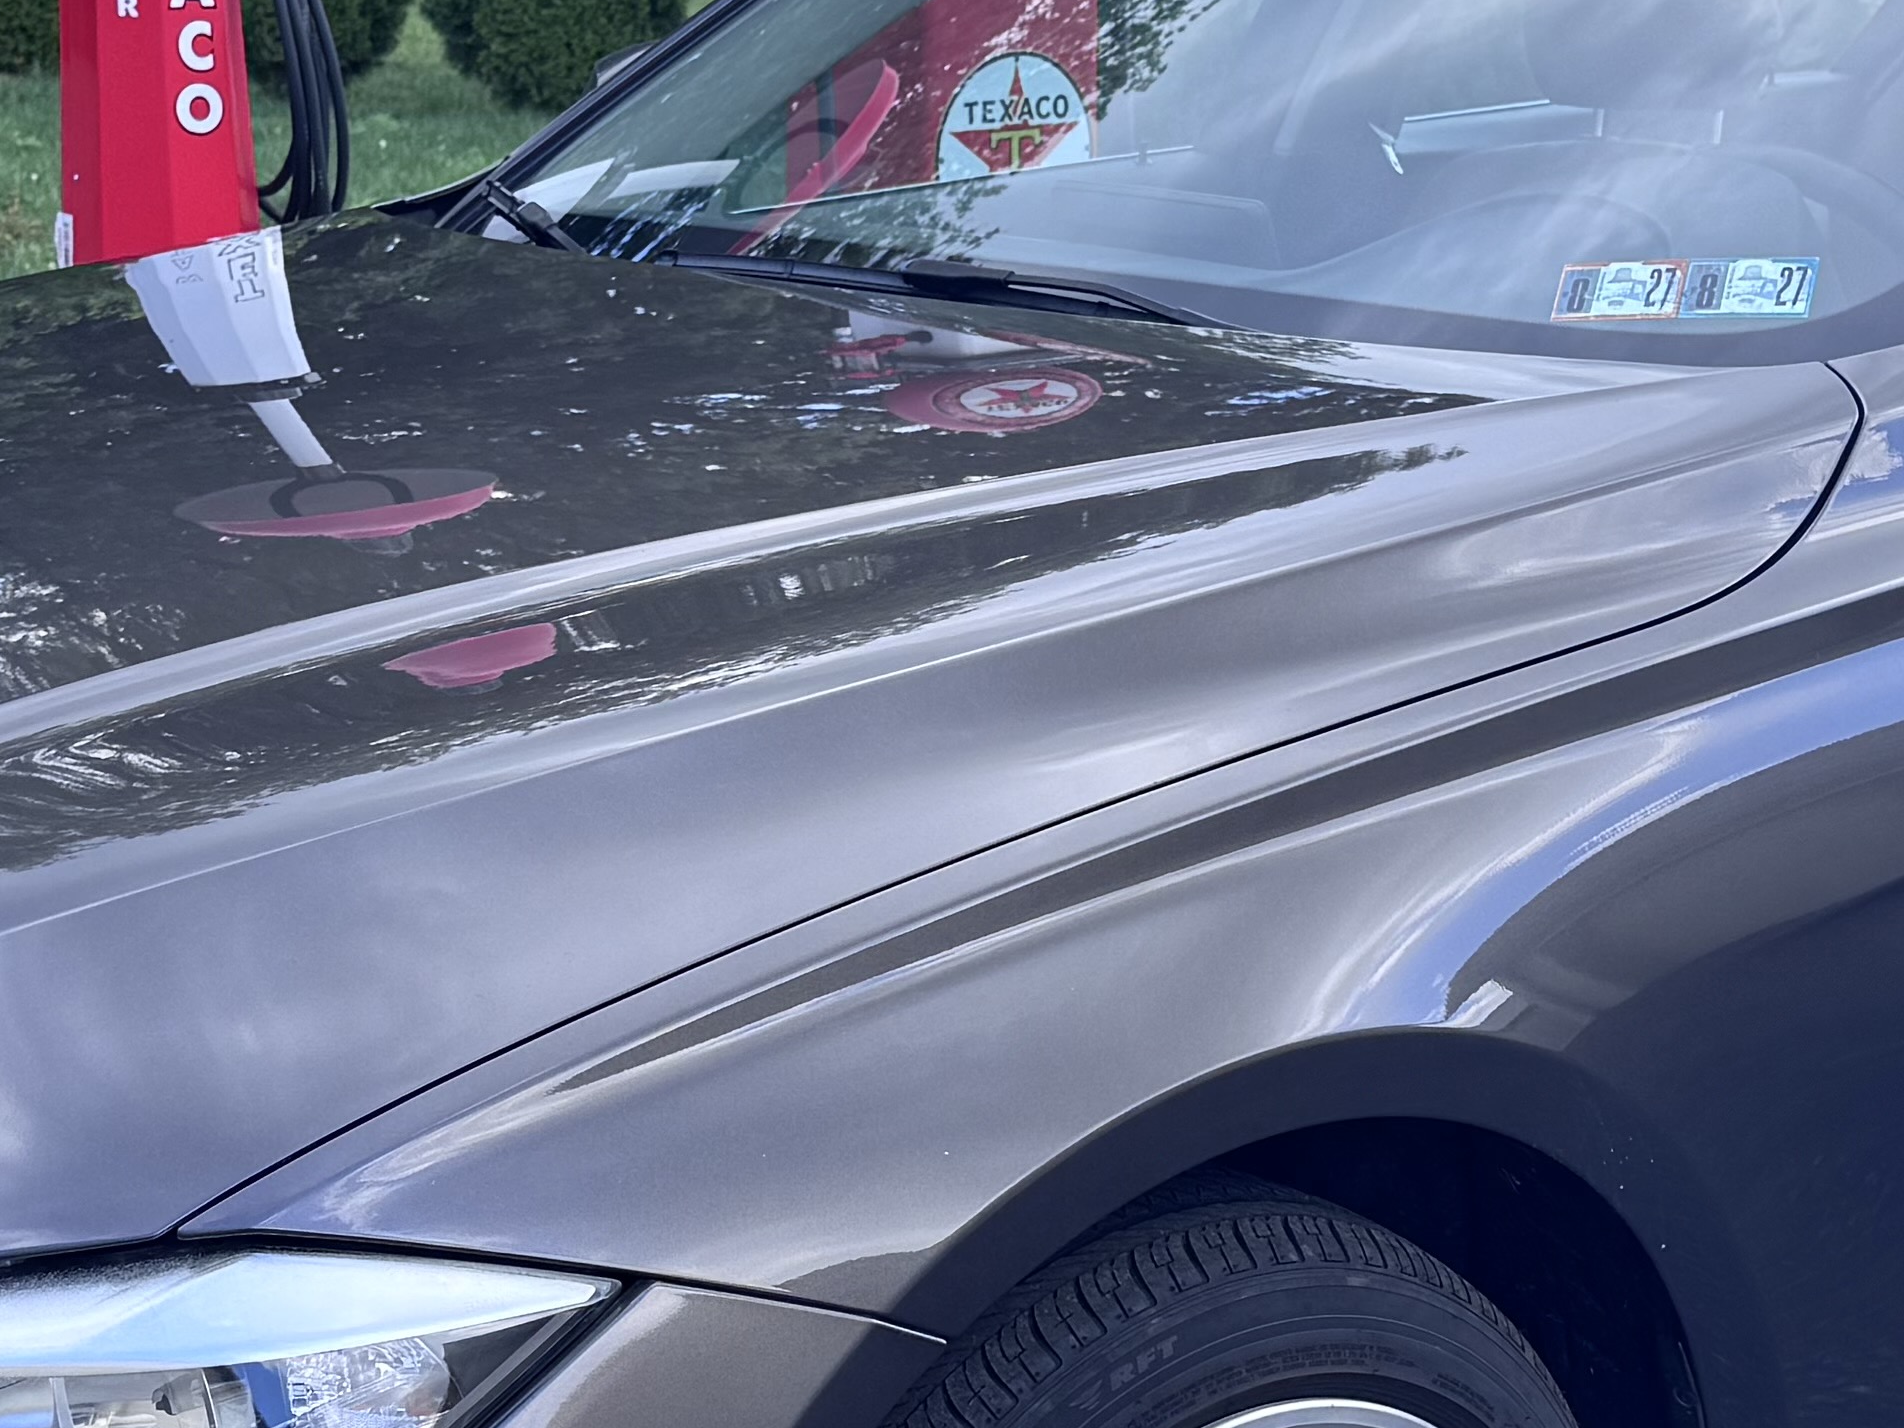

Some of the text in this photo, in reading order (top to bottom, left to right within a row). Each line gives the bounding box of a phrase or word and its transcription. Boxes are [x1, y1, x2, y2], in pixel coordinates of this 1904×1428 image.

[964, 94, 1069, 126] TEXACO
[1643, 267, 1677, 310] 27
[1696, 266, 1809, 309] 8 27
[1109, 1335, 1178, 1392] RFT
